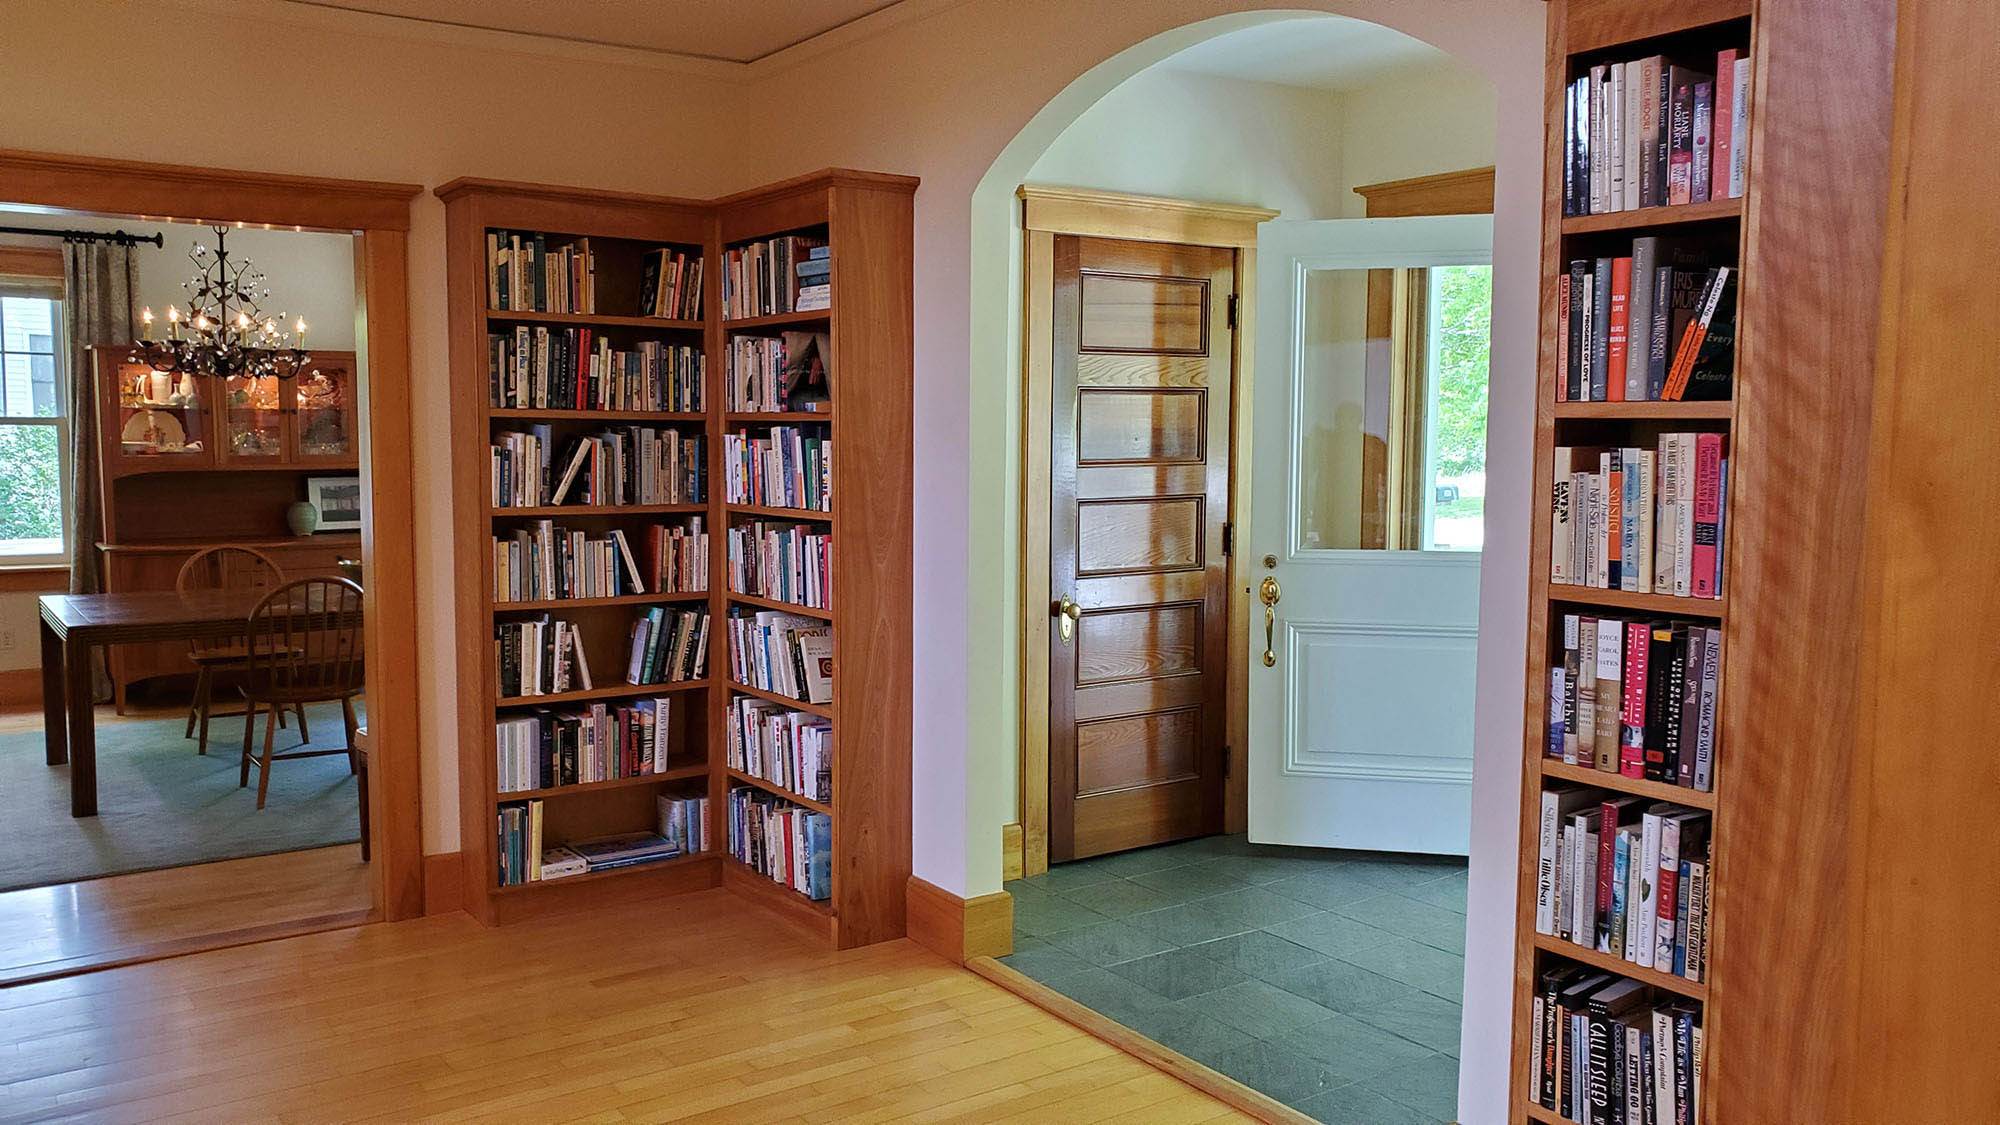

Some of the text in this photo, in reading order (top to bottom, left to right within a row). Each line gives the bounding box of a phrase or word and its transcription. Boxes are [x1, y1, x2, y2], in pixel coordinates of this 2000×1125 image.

[1642, 64, 1652, 131] LORRIE MOORE
[1658, 72, 1670, 162] Lorrie Moore Bark
[1673, 102, 1682, 150] MORIARTY
[1680, 111, 1690, 138] LIANE
[1680, 168, 1688, 194] Three
[1561, 276, 1569, 296] ALICE
[1708, 277, 1724, 304] Celeste
[1560, 296, 1568, 320] MUNRO
[1631, 316, 1640, 339] ALICE
[1583, 353, 1590, 362] OF
[1630, 340, 1638, 368] MUNRO
[1582, 364, 1590, 384] LOVE
[1560, 482, 1570, 524] RAVEN'S
[1588, 488, 1600, 529] Night-Side
[1609, 487, 1620, 535] SOLSTICE
[1625, 518, 1634, 549] MARYA
[1598, 634, 1620, 642] JOYCE
[1676, 658, 1684, 684] LIVES
[1704, 642, 1719, 681] NEMESIS
[1634, 628, 1646, 724] Invisible Writer
[1564, 681, 1576, 733] Balthus
[1623, 694, 1631, 722] Oates
[658, 702, 668, 760] Purity Franzen
[1670, 724, 1679, 754] TWINS
[1698, 740, 1709, 764] SMITH
[1539, 806, 1555, 907] Silences Tillie Olsen
[1687, 875, 1703, 972] WALKER PERCY THE LAST GENTLEMAN
[1546, 991, 1558, 1006] The
[1546, 1005, 1556, 1043] Professor's
[1590, 1022, 1607, 1050] CALL
[1675, 1018, 1687, 1035] My
[1656, 1016, 1668, 1091] Portnoy's Complaint
[1676, 1035, 1687, 1056] Life
[1545, 1044, 1556, 1076] Daughter
[1590, 1053, 1607, 1069] IT
[1644, 1050, 1652, 1074] When
[1676, 1057, 1684, 1067] as
[1590, 1068, 1608, 1107] SLEEP
[1614, 1060, 1624, 1097] Columbus
[1628, 1053, 1639, 1108] LETTING GO
[1677, 1074, 1688, 1098] Man
[1644, 1106, 1653, 1125] Good
